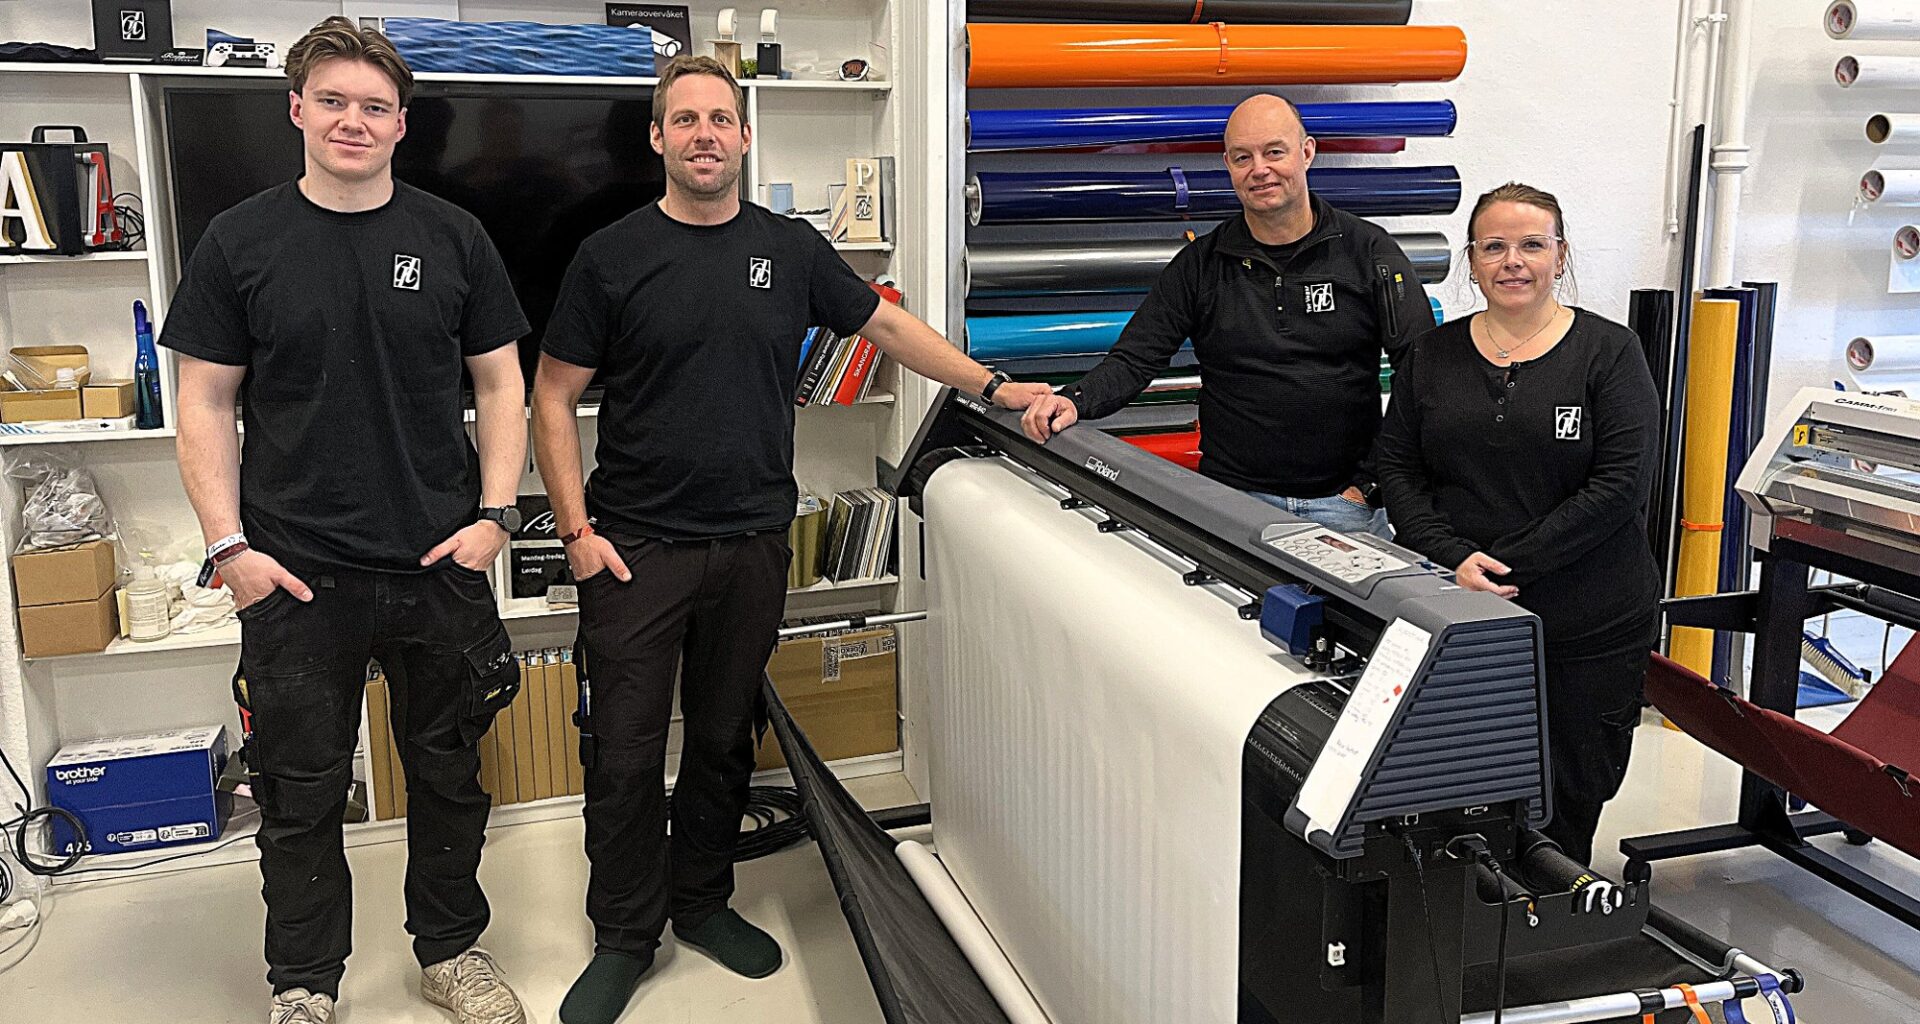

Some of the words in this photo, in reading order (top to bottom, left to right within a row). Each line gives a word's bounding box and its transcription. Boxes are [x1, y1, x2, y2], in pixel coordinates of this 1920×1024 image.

[611, 8, 684, 18] Kameraovervåket
[856, 162, 873, 187] P
[1094, 460, 1120, 481] Roland
[56, 766, 106, 780] brother
